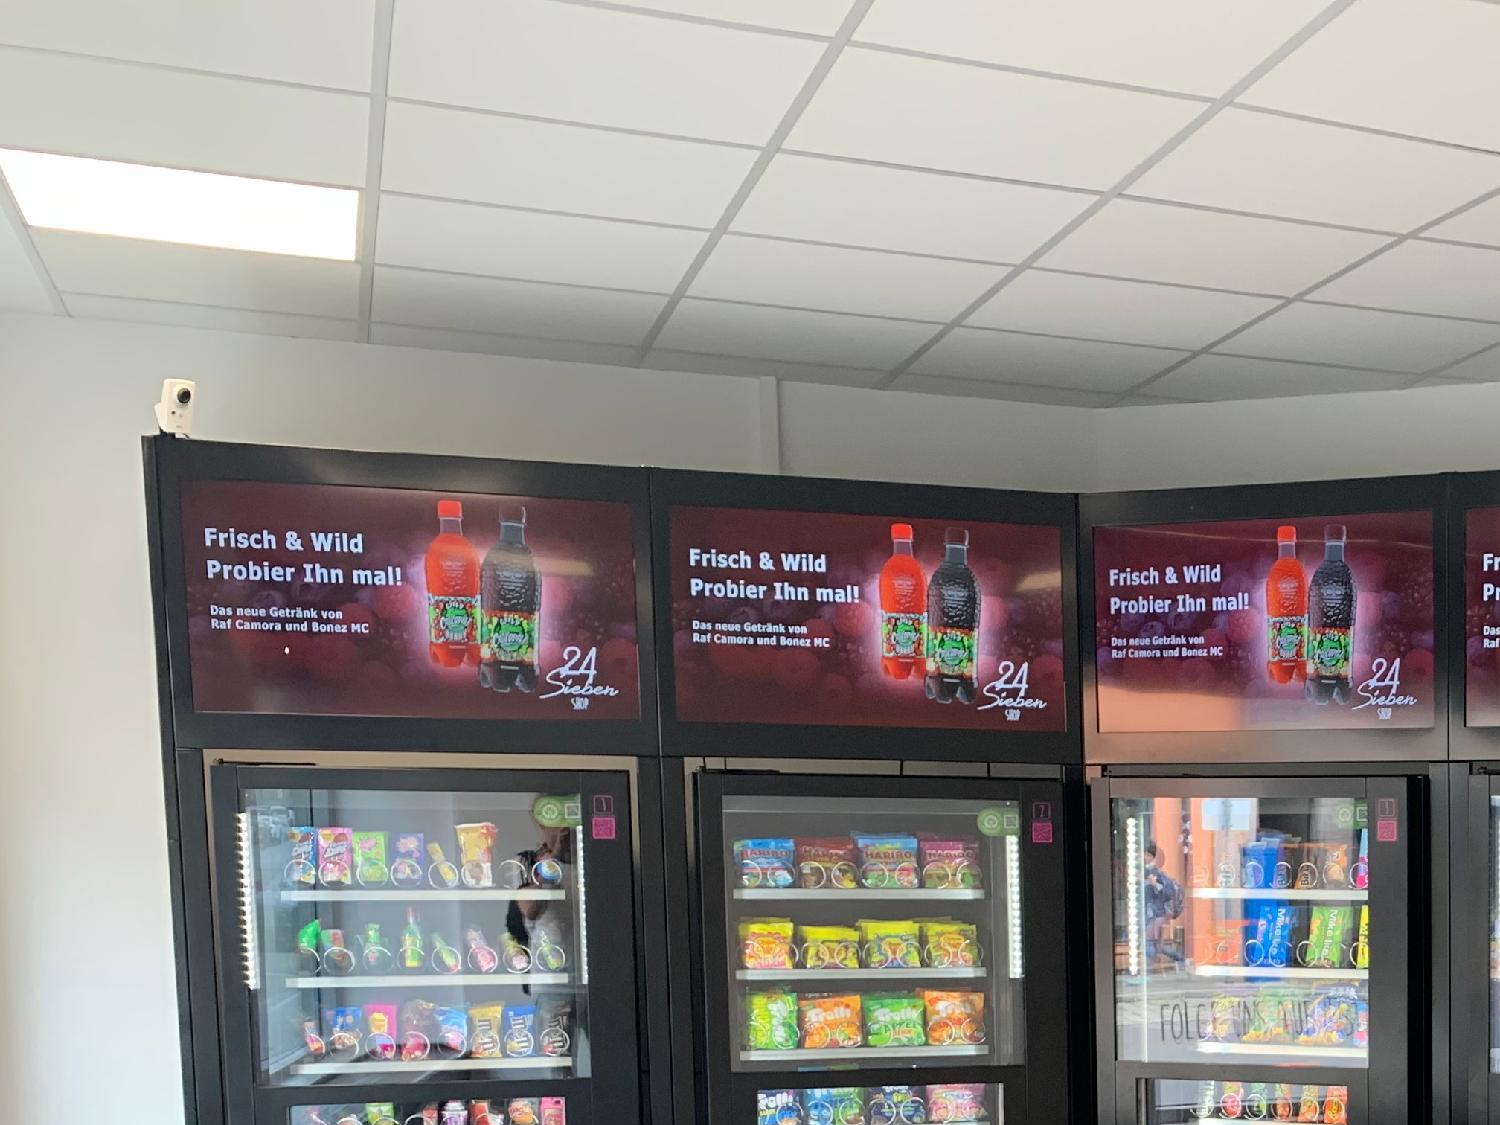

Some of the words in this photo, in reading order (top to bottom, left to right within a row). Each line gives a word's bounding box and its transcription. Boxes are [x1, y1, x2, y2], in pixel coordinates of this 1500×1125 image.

[205, 528, 276, 549] Frisch
[286, 531, 304, 550] &
[310, 533, 362, 553] Wild
[690, 549, 751, 568] Frisch
[760, 552, 775, 570] &
[781, 553, 826, 572] Wild
[207, 560, 295, 581] Probier
[303, 564, 343, 583] Ihn
[353, 566, 402, 586] mal!
[1110, 567, 1158, 586] Frisch
[1165, 567, 1178, 583] &
[1183, 564, 1220, 583] Wild
[691, 579, 767, 599] Probier
[774, 582, 808, 600] Ihn
[816, 585, 859, 603] mal!
[211, 605, 232, 615] Das
[237, 608, 266, 616] neue
[269, 607, 317, 618] Getränk
[321, 611, 342, 619] von
[1111, 596, 1171, 614] Probier
[1177, 594, 1205, 612] Ihn
[1213, 592, 1250, 610] mal!
[211, 619, 231, 629] Raf
[236, 620, 281, 630] Camora
[286, 621, 307, 631] und
[351, 624, 368, 633] MC
[693, 621, 711, 630] Das
[744, 622, 786, 634] Getränk
[1484, 626, 1500, 635] Das
[693, 633, 711, 643] Raf
[714, 634, 754, 644] Camora
[757, 635, 776, 645] und
[814, 638, 829, 647] MC
[1112, 638, 1126, 646] Das
[1153, 634, 1185, 646] Getränk
[1188, 636, 1204, 644] von
[1484, 638, 1500, 648] Raf
[1112, 649, 1126, 658] Raf
[1129, 649, 1160, 658] Camora
[1163, 647, 1179, 656] und
[1210, 647, 1223, 656] MC
[562, 647, 597, 681] 24
[1372, 658, 1400, 692] 24
[540, 669, 618, 698] Sieben
[998, 661, 1028, 697] 24
[977, 681, 1047, 709] Sieben
[1352, 680, 1417, 710] Sieben
[863, 848, 913, 860] HARIBO
